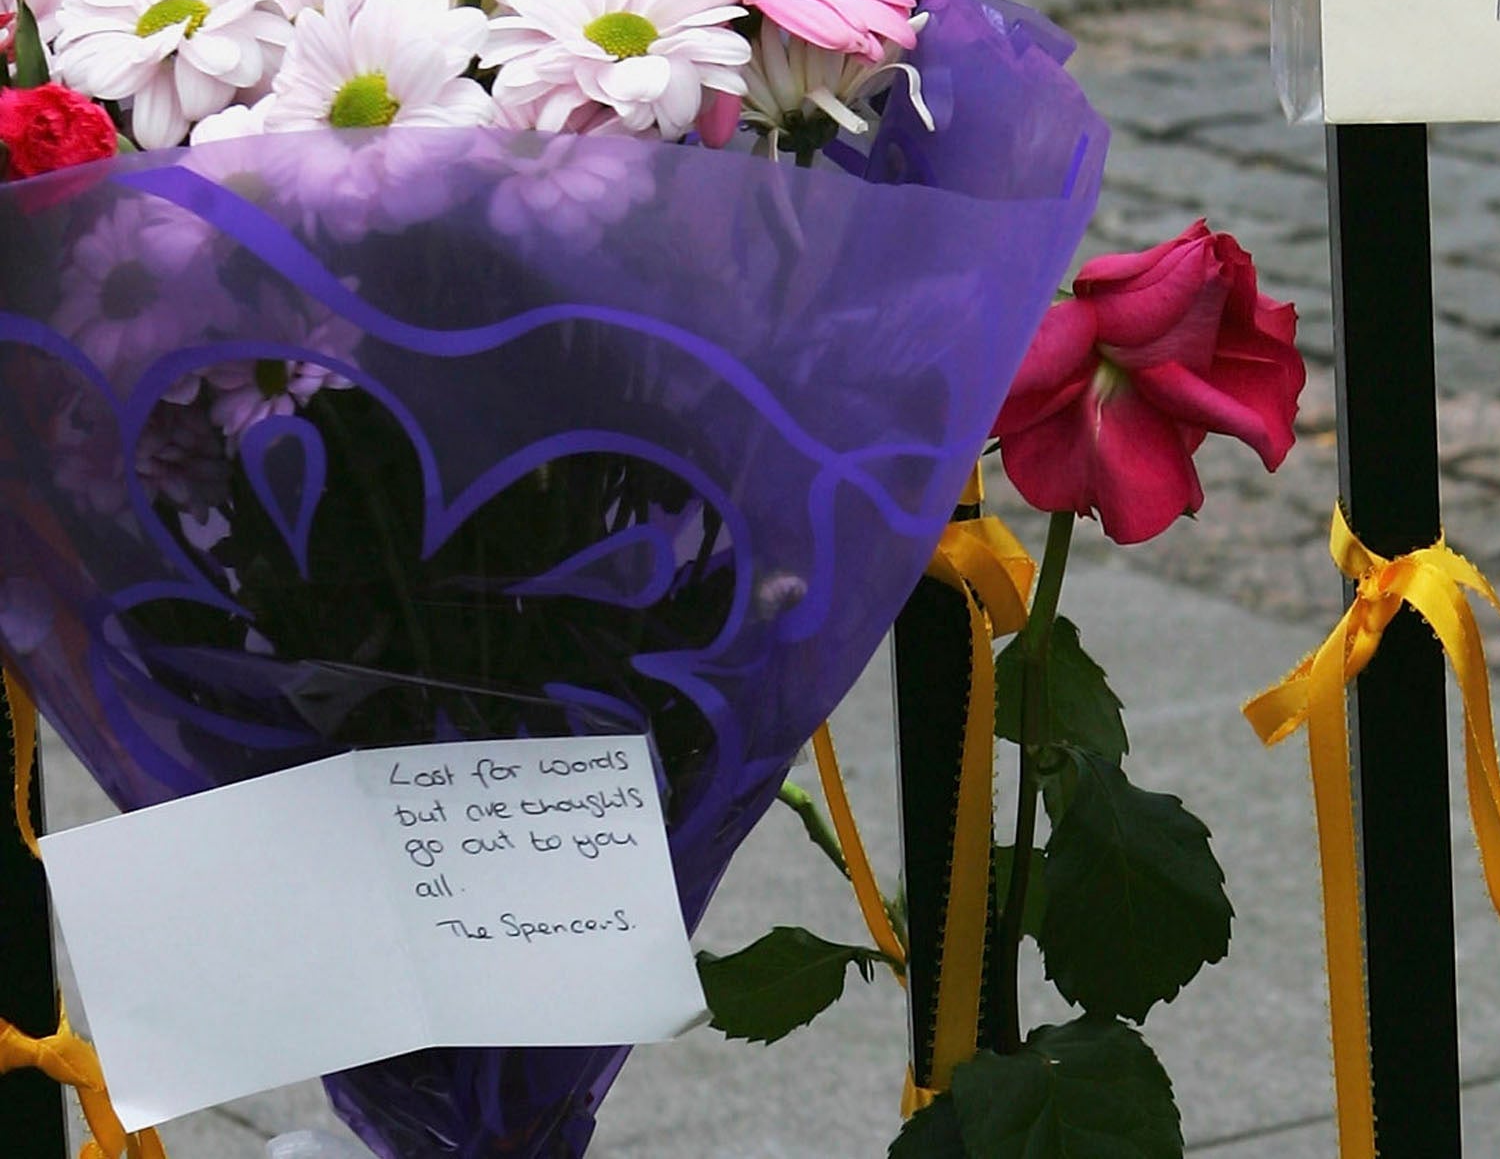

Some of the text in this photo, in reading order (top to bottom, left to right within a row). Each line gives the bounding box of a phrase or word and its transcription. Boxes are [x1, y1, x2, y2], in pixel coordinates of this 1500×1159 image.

[389, 750, 630, 789] Lost for words
[394, 800, 448, 828] but
[520, 786, 645, 818] thoughts
[404, 829, 639, 868] go out to you
[435, 918, 493, 940] The
